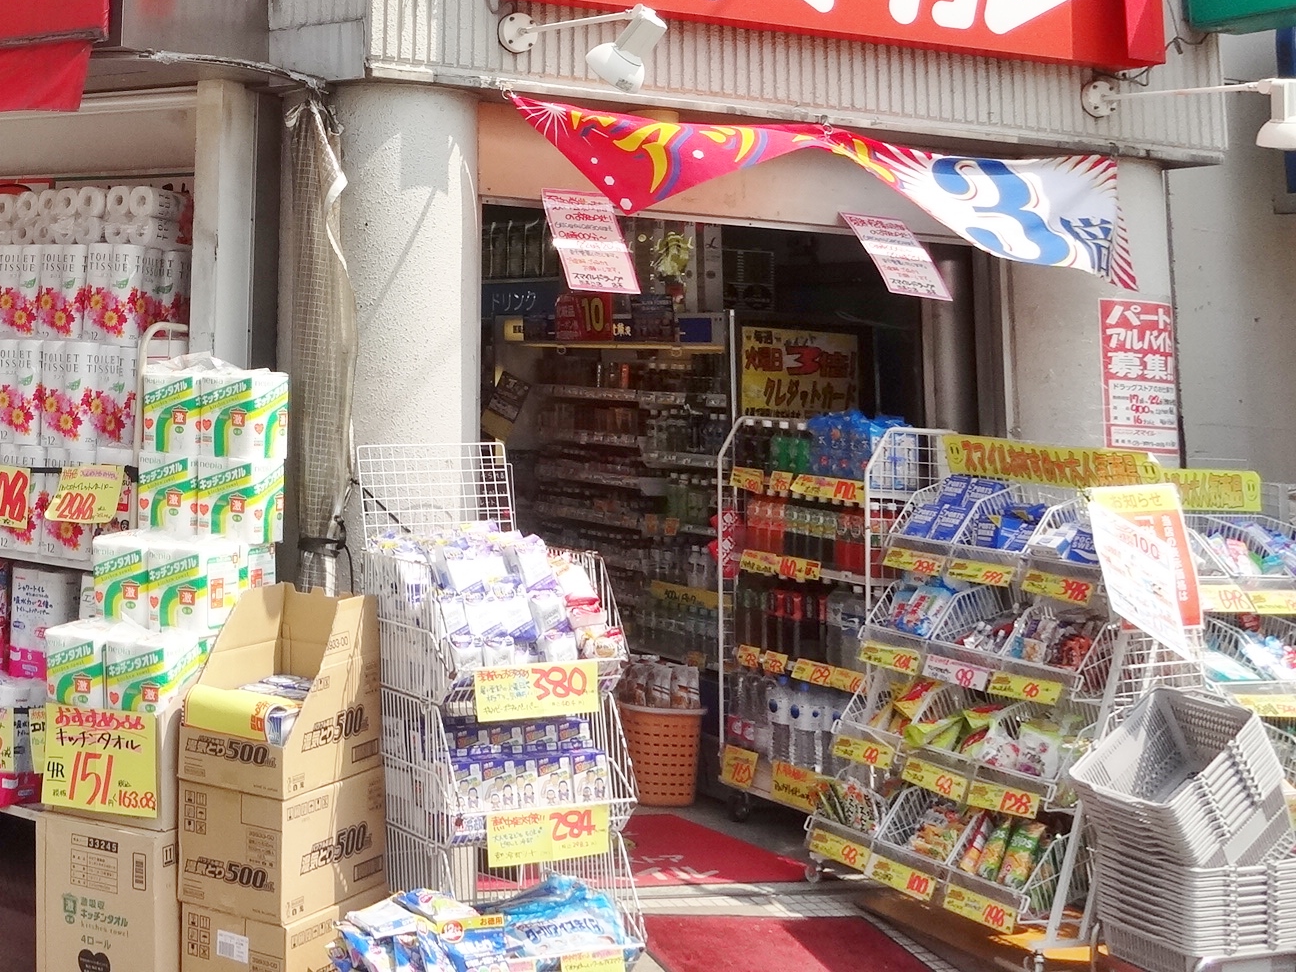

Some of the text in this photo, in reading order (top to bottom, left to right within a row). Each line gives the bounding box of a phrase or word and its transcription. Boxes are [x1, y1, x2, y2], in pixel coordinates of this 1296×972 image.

[0, 253, 36, 263] TOILET
[0, 263, 36, 273] TISSUE
[89, 252, 129, 263] TOILET
[89, 262, 129, 273] TISSUE
[491, 291, 537, 312] ドリンク
[581, 296, 605, 332] 10
[1105, 304, 1171, 329] パート
[1106, 328, 1172, 353] アルバイト
[1107, 351, 1174, 381] 募集!!
[144, 380, 192, 406] キッチンタオル
[201, 382, 247, 406] キッチンタオル
[1133, 415, 1143, 425] 16
[139, 462, 183, 485] キッチンタオル
[198, 468, 247, 490] キッチンタオル
[1109, 492, 1164, 509] お知らせ
[94, 553, 141, 576] キッチンタオル
[148, 558, 197, 581] キッチンタオル
[108, 651, 160, 675] キッチンタオル
[530, 666, 588, 701] 380
[954, 668, 975, 688] 98
[55, 728, 142, 751] キッチンタオル
[46, 761, 65, 778] 4R
[68, 750, 114, 806] 151
[999, 790, 1033, 815] 128
[548, 808, 597, 842] 284
[88, 837, 118, 853] 33245
[80, 909, 129, 928] キッチンタオル
[479, 916, 504, 926] お徳用
[80, 934, 112, 950] 4ロール
